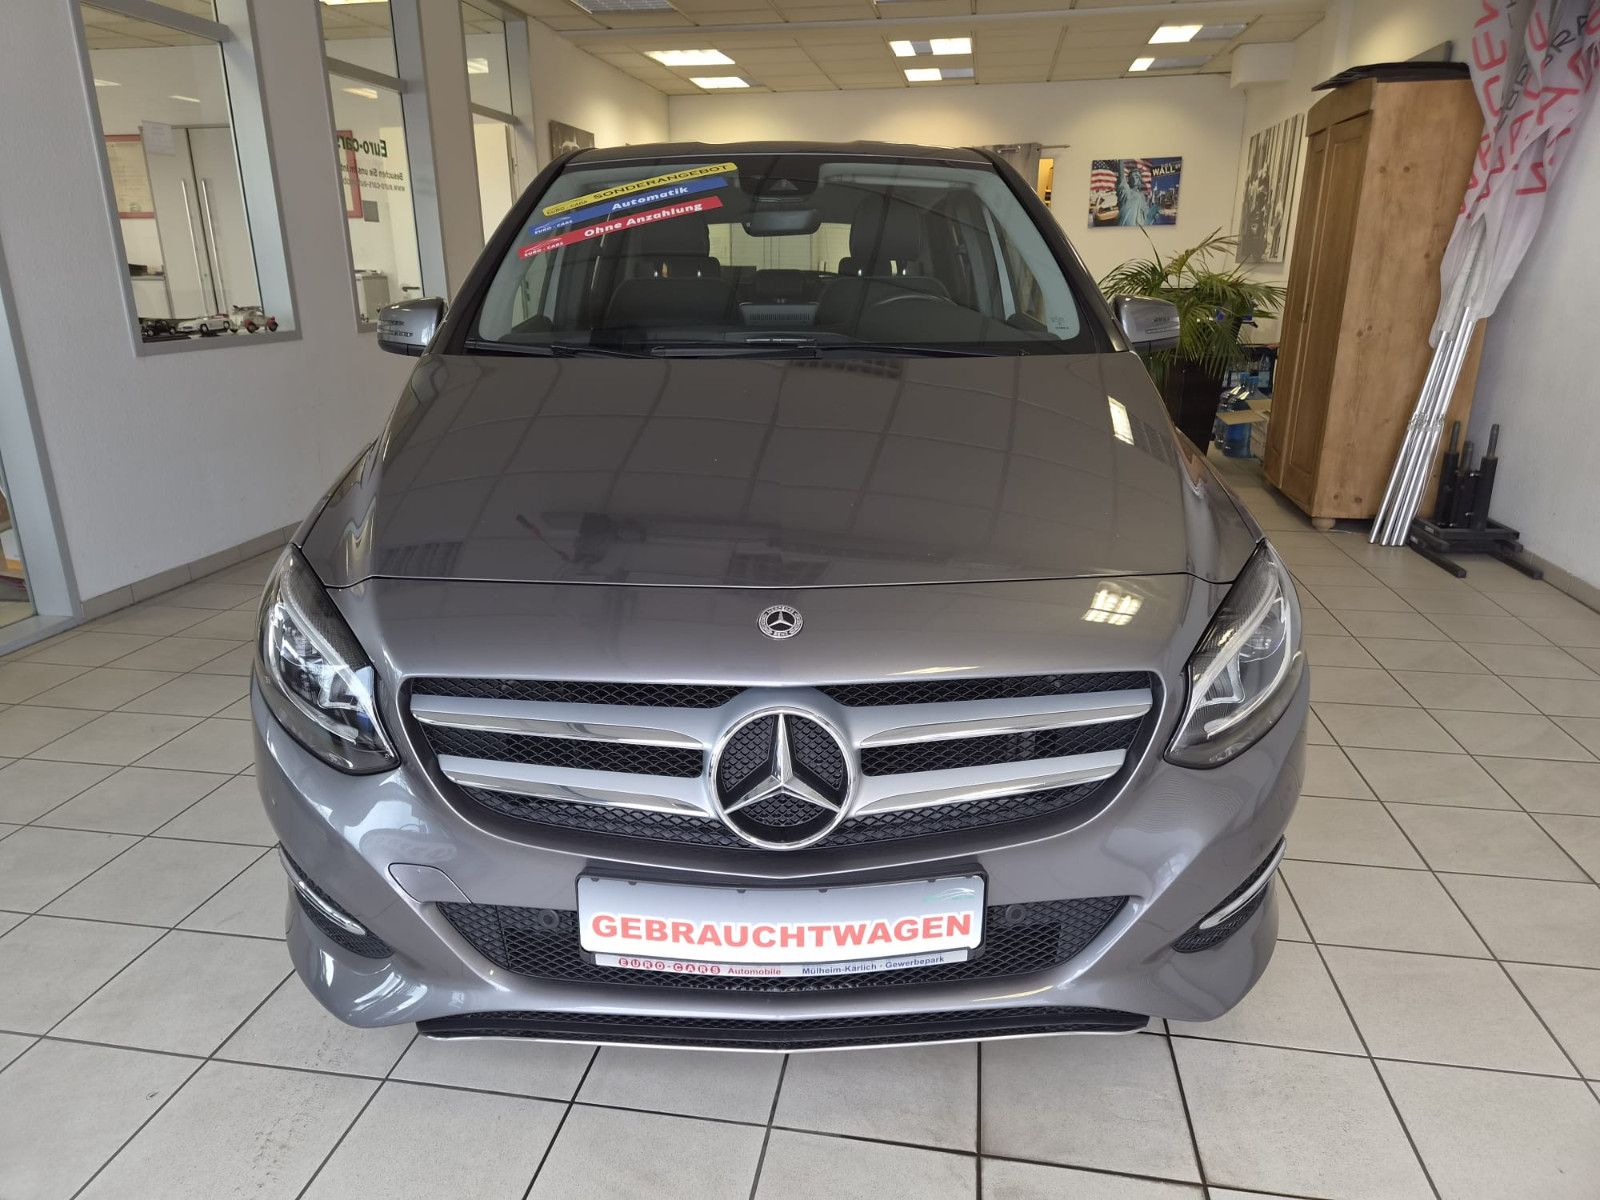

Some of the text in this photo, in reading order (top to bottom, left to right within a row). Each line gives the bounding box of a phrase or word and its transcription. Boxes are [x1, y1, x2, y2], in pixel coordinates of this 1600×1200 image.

[593, 165, 728, 200] SONDERANGEBOT
[1152, 164, 1176, 176] WALL
[534, 226, 552, 235] EURO
[556, 219, 573, 228] CARS
[611, 186, 689, 211] Automatik
[524, 248, 542, 257] EURO
[547, 241, 564, 250] CARS
[584, 222, 623, 237] Ohne
[626, 203, 703, 226] Anzahlung
[591, 914, 971, 948] GEBRAUCHTWAGEN
[728, 966, 782, 976] Automobile
[802, 962, 877, 975] Mülheim-Kärlich
[885, 955, 945, 970] Gewerbepark
